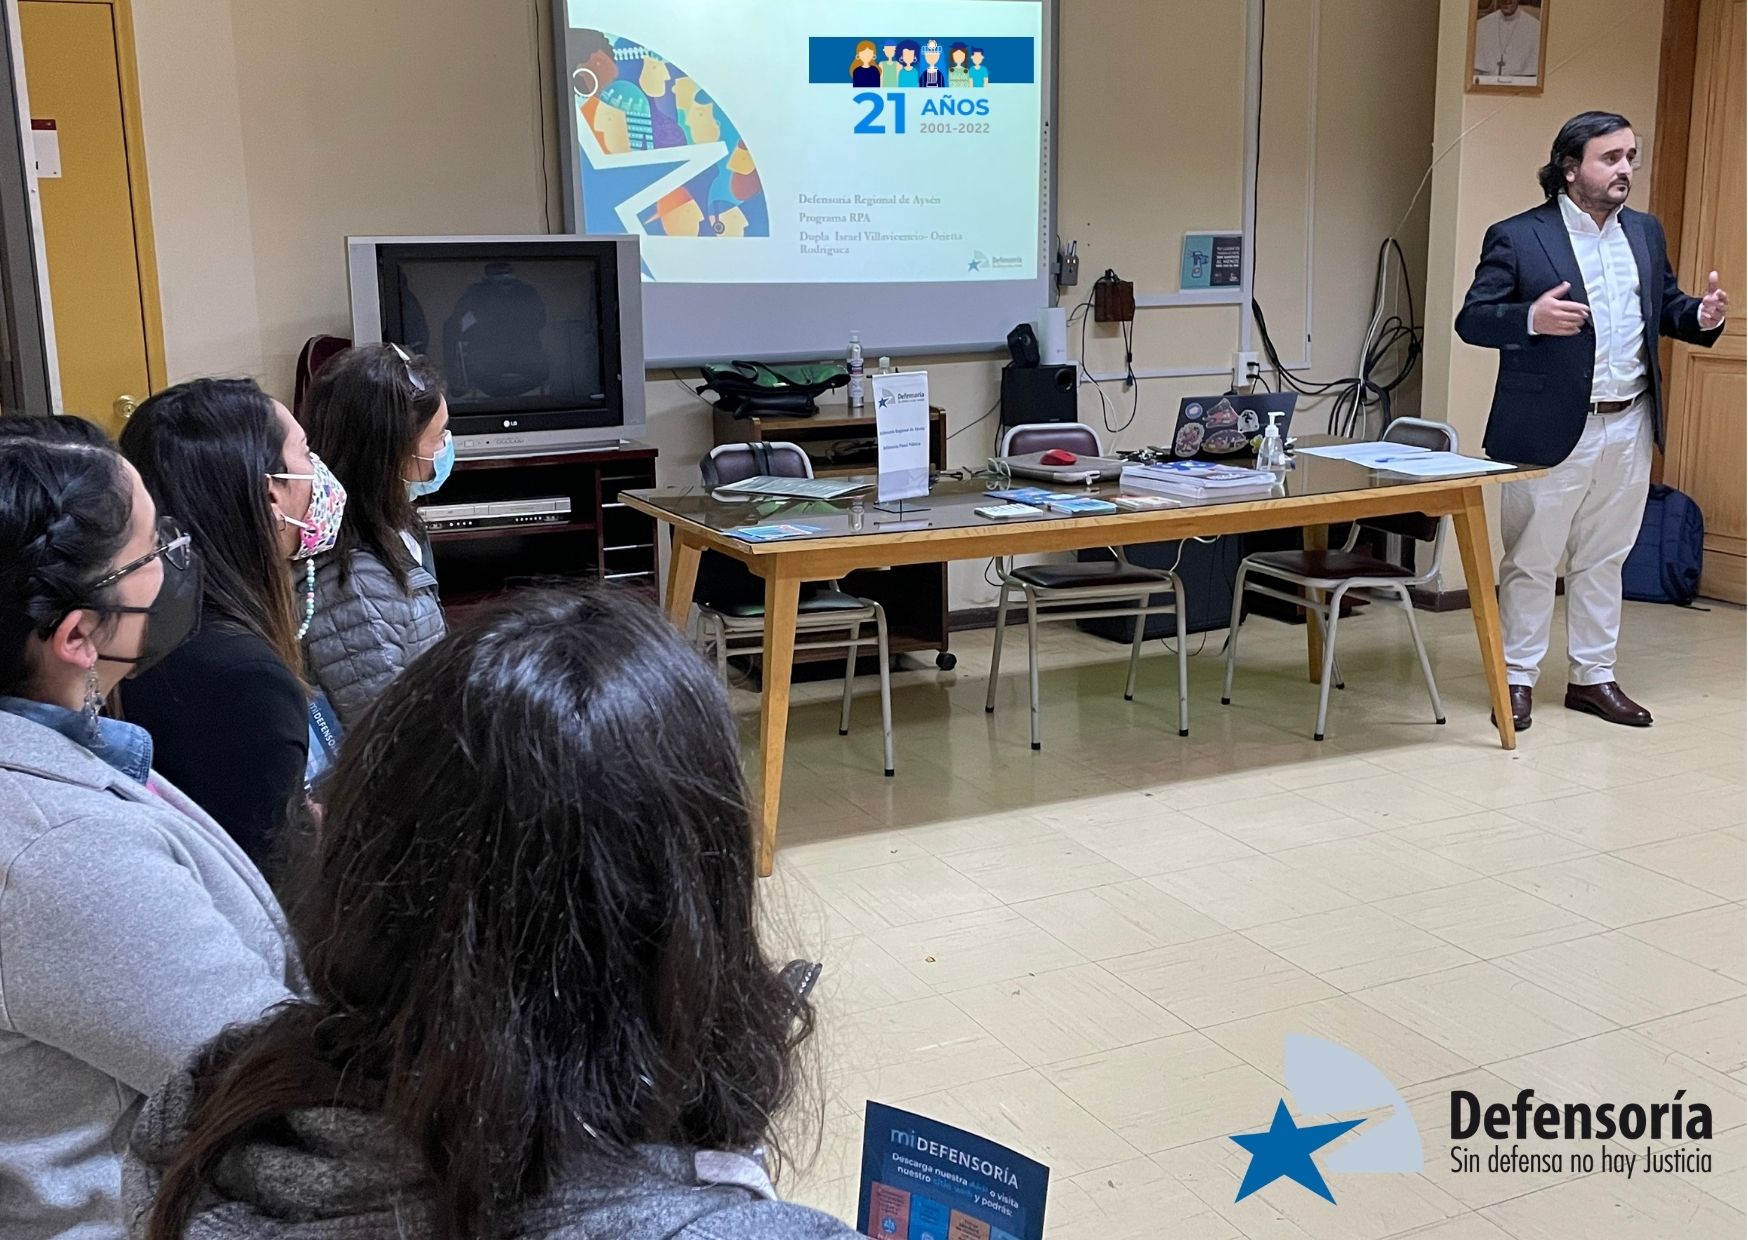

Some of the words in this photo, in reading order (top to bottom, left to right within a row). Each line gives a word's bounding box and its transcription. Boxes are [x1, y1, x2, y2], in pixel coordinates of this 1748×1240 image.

[852, 92, 906, 134] 21
[920, 94, 990, 116] AÑOS
[920, 122, 990, 134] 2001-2022
[854, 194, 896, 207] Regional
[899, 194, 910, 205] de
[799, 212, 847, 224] Programa
[849, 212, 871, 223] RPA
[799, 231, 829, 243] Dupla
[835, 231, 862, 241] Israel
[892, 1152, 933, 1173] Descarga
[935, 1168, 968, 1186] nuestra
[989, 1190, 996, 1198] o
[997, 1192, 1019, 1209] visita
[897, 1166, 931, 1183] nuestro
[974, 1193, 981, 1203] y
